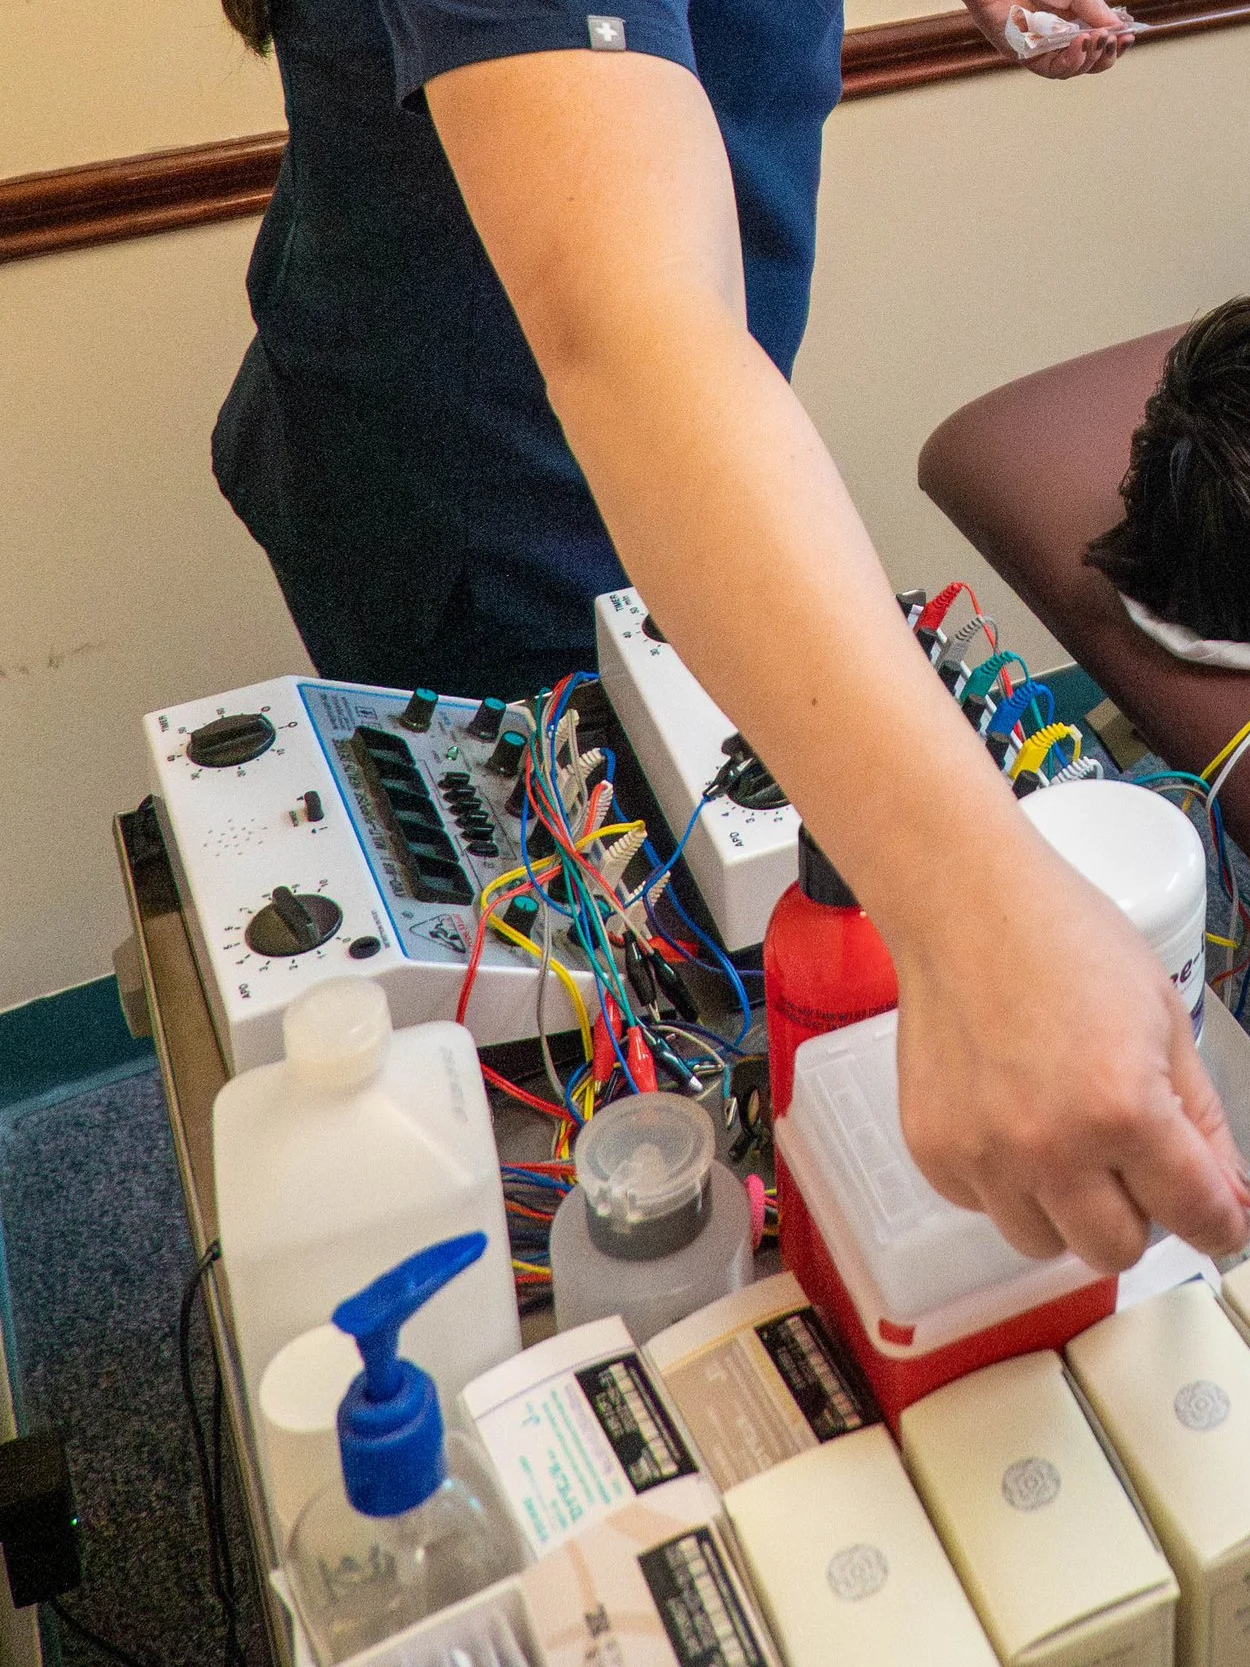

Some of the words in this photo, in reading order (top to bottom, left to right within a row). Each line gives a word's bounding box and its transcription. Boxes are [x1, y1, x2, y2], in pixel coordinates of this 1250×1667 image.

[609, 594, 623, 612] TIMER
[158, 714, 169, 732] TIMER
[730, 832, 744, 847] APD
[238, 983, 252, 998] APD
